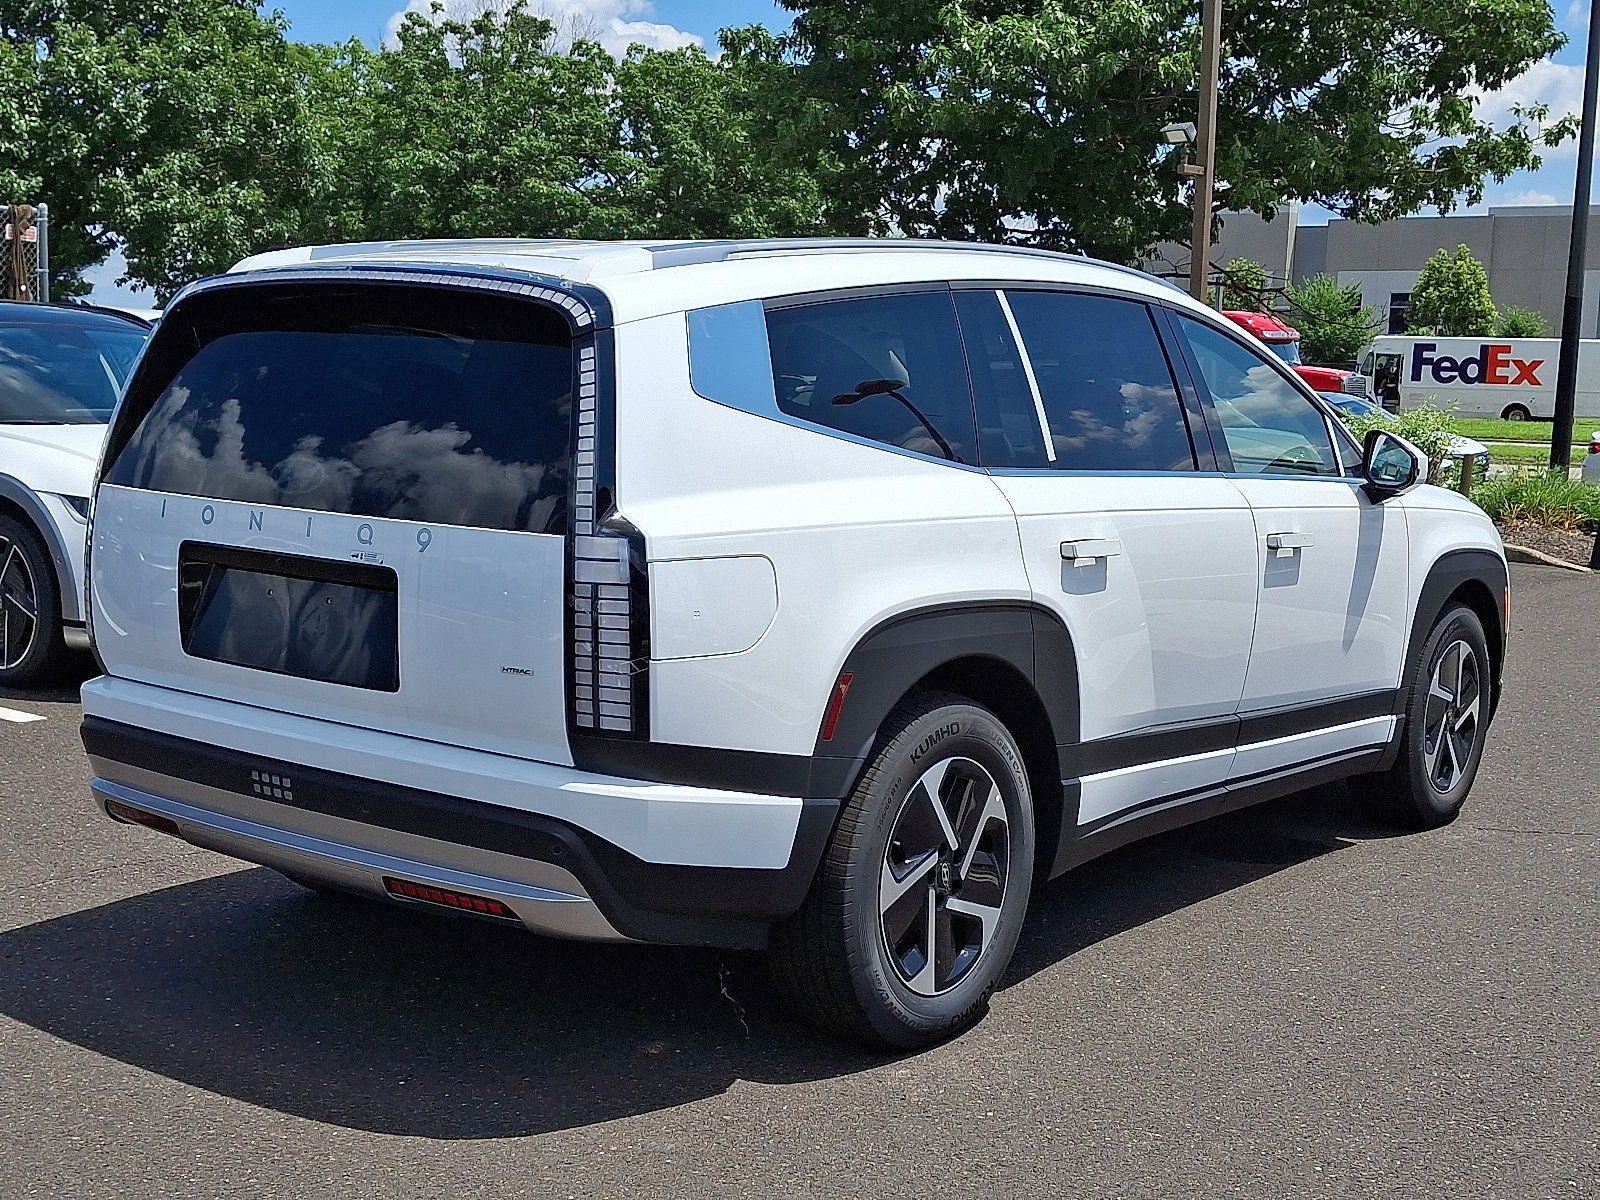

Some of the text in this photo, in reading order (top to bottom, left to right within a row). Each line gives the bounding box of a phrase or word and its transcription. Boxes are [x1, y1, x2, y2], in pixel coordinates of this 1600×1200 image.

[1411, 343, 1545, 386] FedEx
[502, 666, 531, 675] HTRAC
[909, 721, 960, 764] KUMHO
